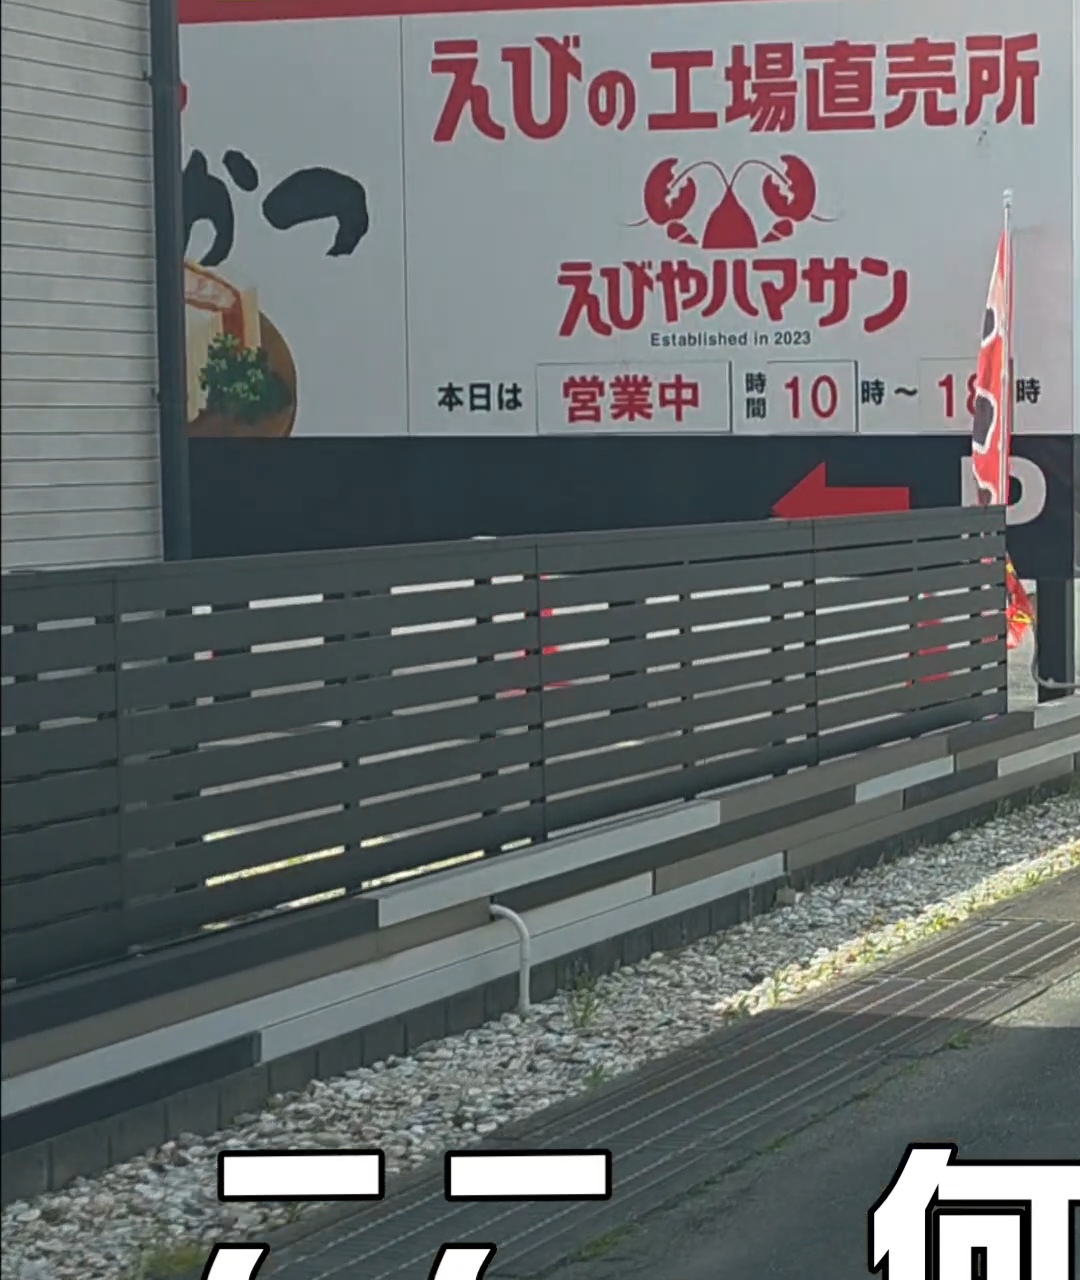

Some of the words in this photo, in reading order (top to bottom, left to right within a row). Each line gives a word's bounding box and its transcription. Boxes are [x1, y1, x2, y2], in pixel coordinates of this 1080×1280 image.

[430, 34, 1040, 142] えびの工場直売所
[557, 257, 908, 336] えびやハマサン
[650, 332, 747, 347] Established
[753, 332, 769, 346] in
[774, 331, 812, 346] 2023
[437, 383, 523, 412] 本日は
[562, 375, 700, 423] 営業中
[784, 375, 838, 419] 10
